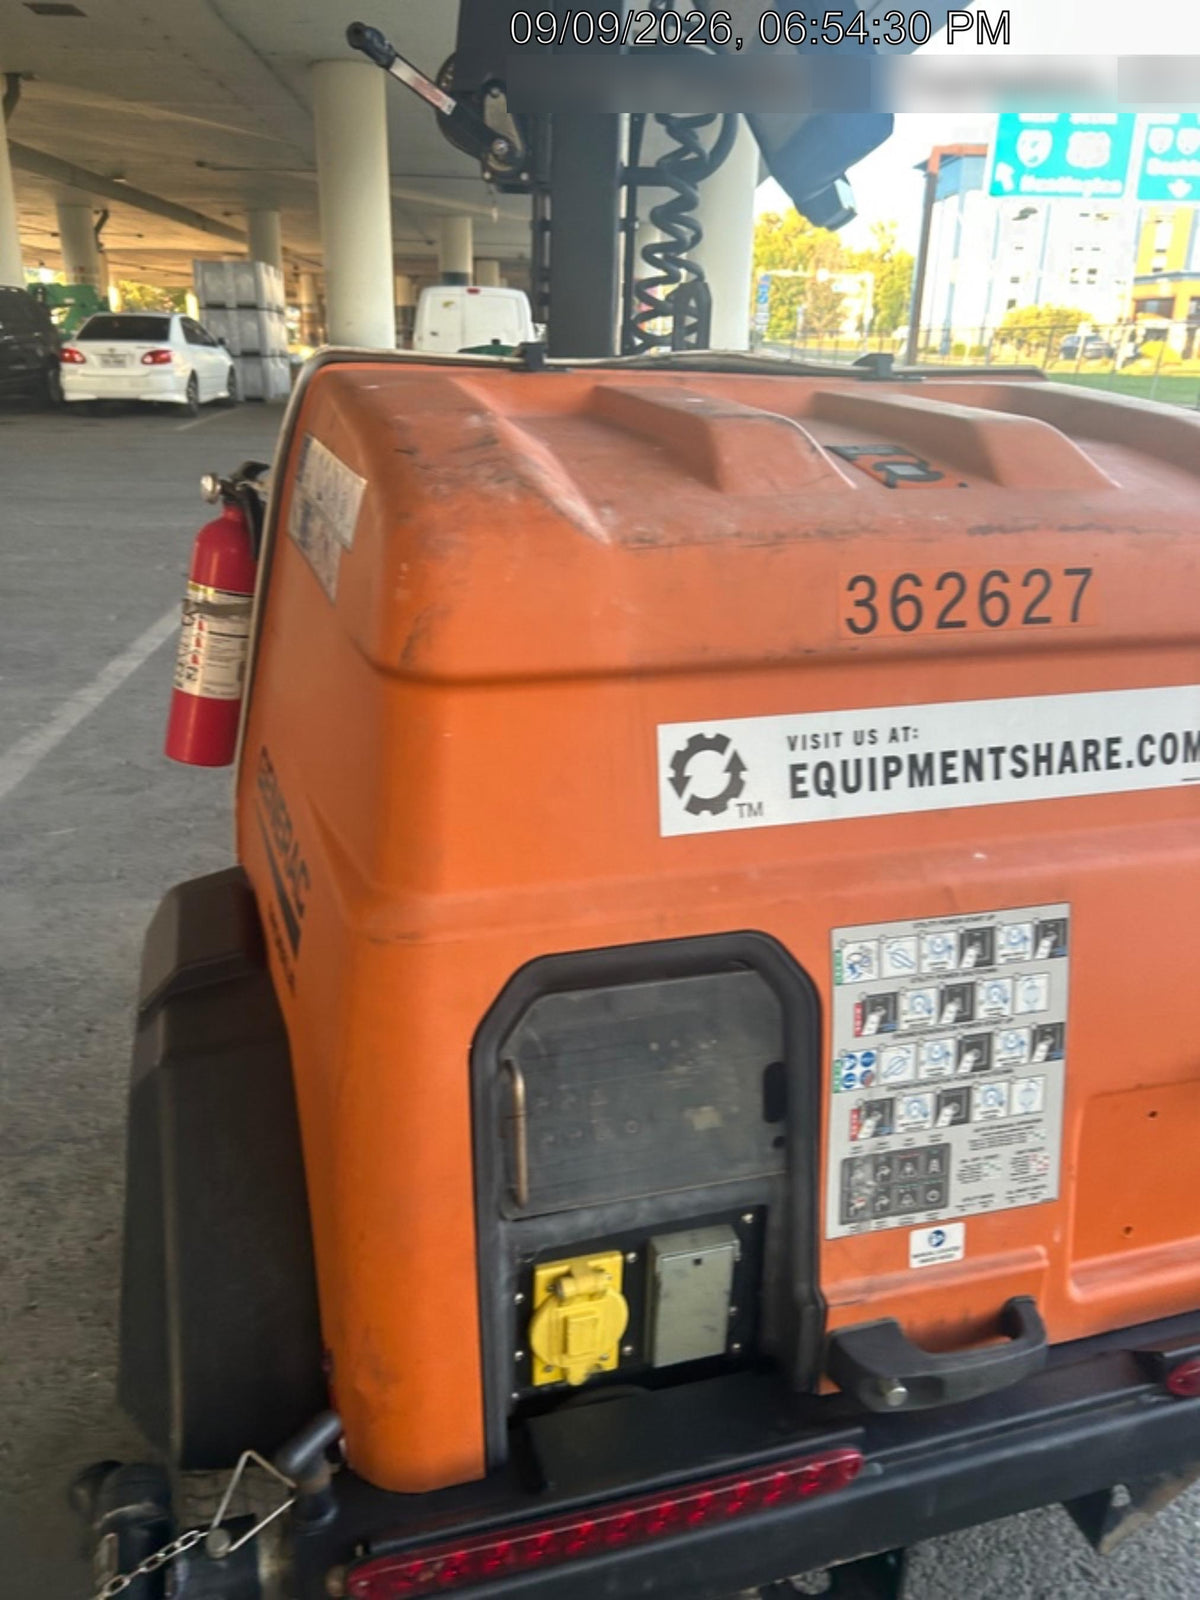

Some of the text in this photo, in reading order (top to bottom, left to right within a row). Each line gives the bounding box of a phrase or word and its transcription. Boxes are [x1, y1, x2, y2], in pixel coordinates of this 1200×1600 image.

[844, 567, 1094, 636] 362627
[786, 725, 920, 753] VISIT US AT:
[788, 729, 1200, 800] EQUIPMENTSHARE.COM
[734, 801, 764, 819] TM
